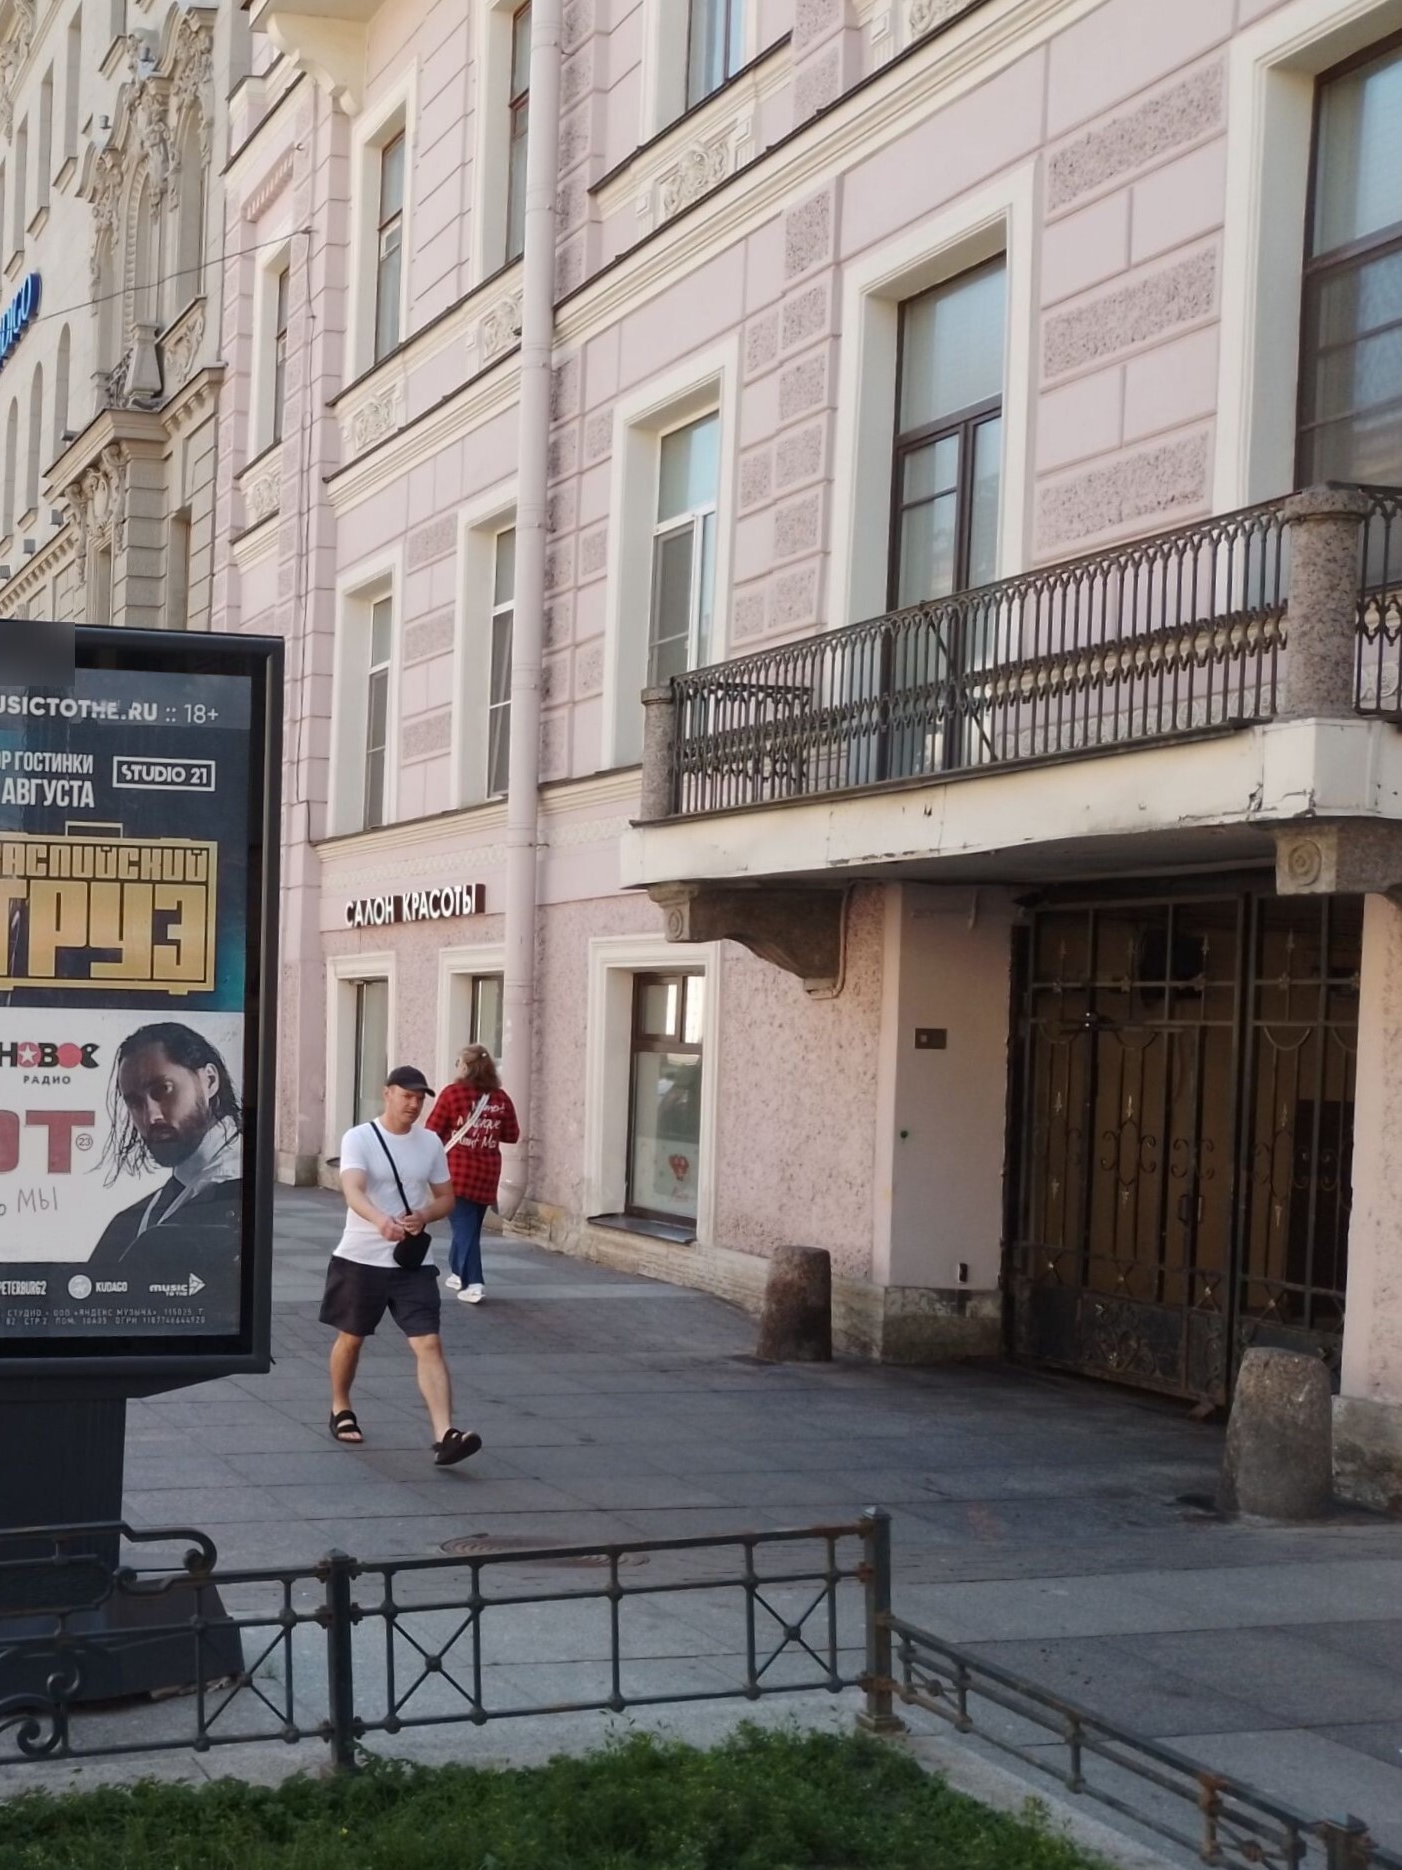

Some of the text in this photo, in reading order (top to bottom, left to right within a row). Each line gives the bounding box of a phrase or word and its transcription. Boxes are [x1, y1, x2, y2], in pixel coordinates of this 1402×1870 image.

[184, 703, 219, 724] 18+
[14, 751, 94, 774] ГОСТИНКИ
[121, 764, 208, 784] STUDIO 21
[1, 777, 95, 808] АВГУСТА
[344, 883, 476, 928] САЛОН КРАСОТЫ
[23, 1075, 71, 1085] РАДИО
[79, 1138, 91, 1147] 23
[96, 1281, 128, 1293] KUDAGO
